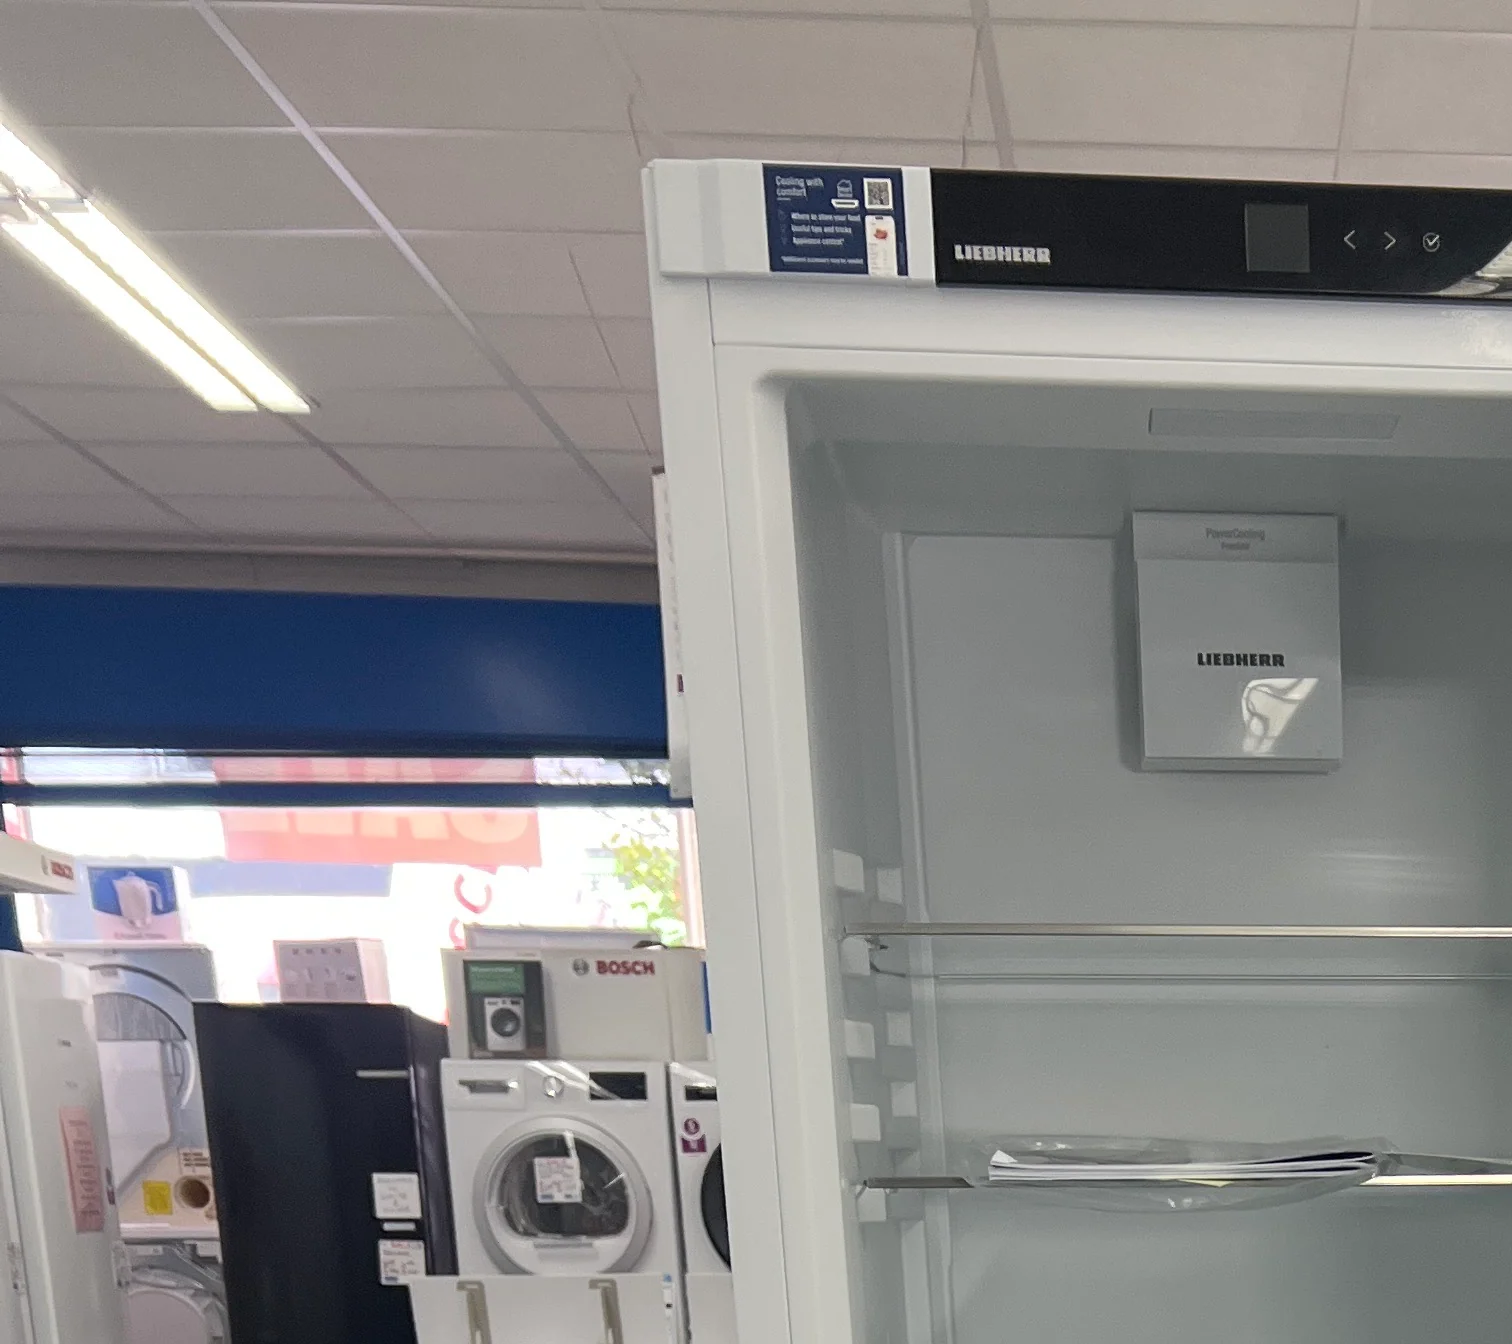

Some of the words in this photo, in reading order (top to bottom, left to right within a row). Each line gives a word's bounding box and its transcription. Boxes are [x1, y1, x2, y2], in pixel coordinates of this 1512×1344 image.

[954, 244, 1051, 264] LIEBHERR
[1197, 652, 1285, 668] LIEBHERR
[596, 959, 656, 976] BOSCH
